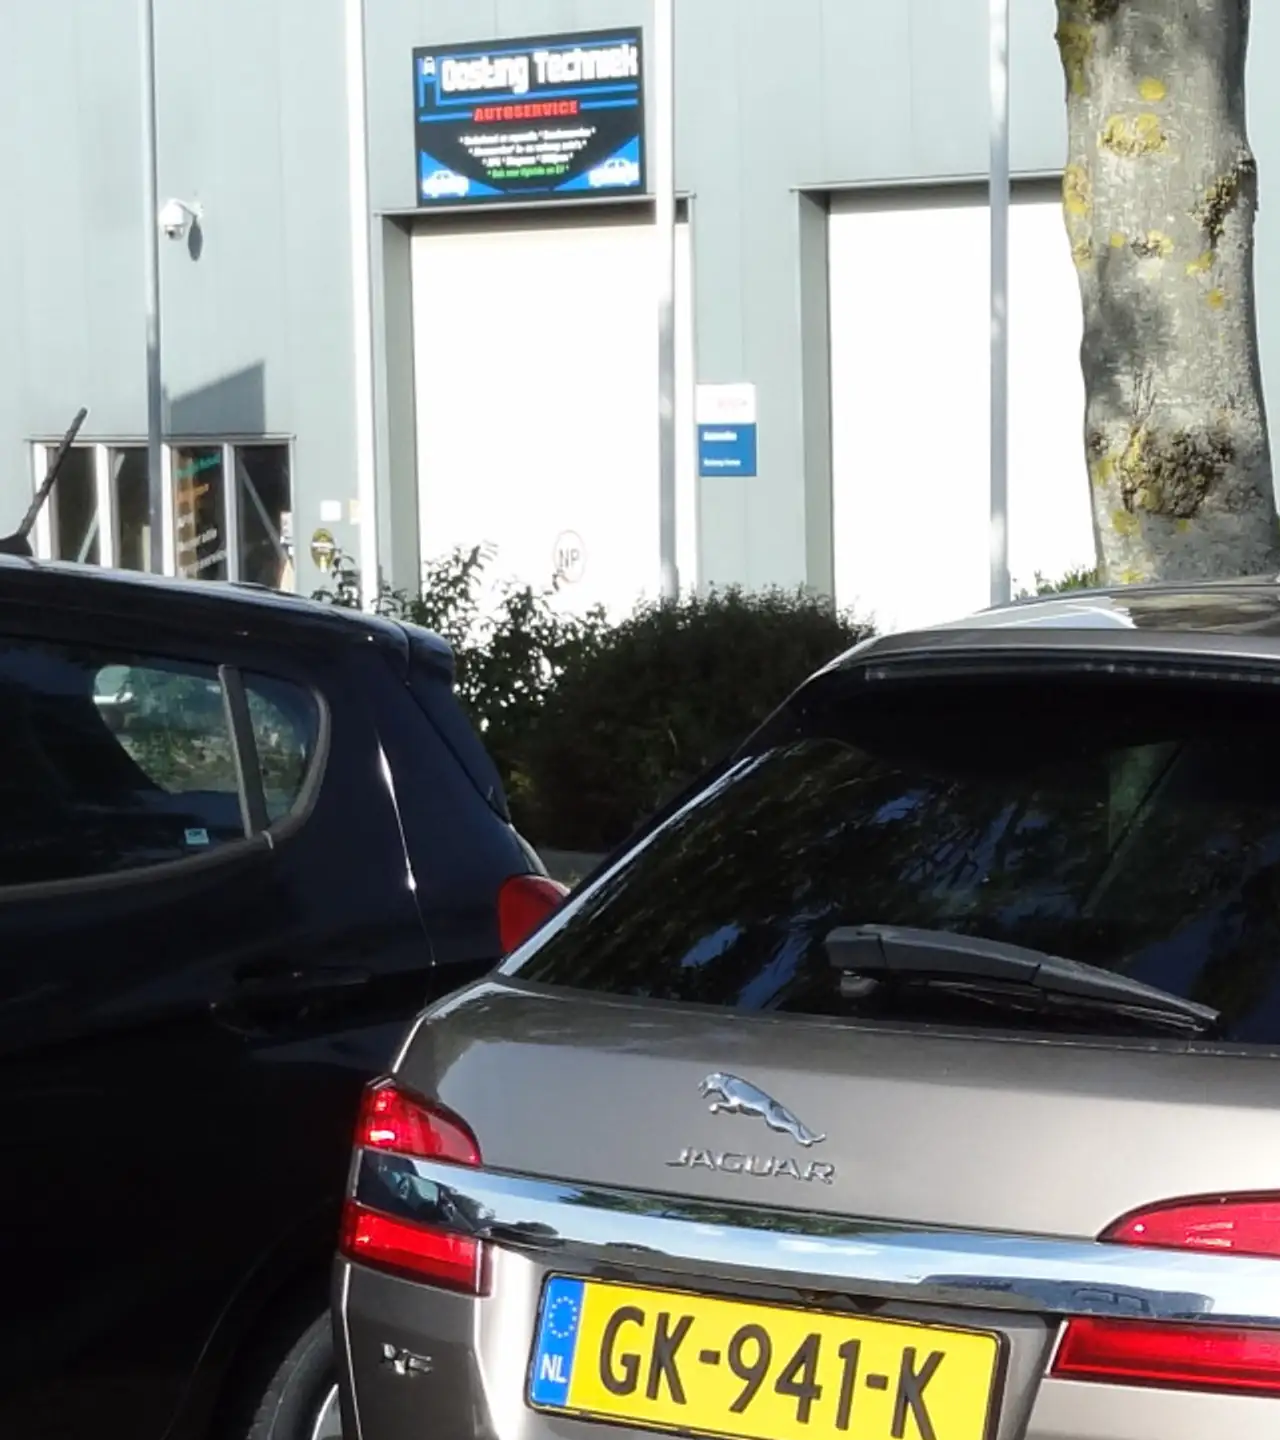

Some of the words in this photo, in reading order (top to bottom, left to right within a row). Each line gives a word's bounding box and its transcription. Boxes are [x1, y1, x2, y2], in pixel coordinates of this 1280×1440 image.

[533, 43, 639, 84] Techniek
[473, 100, 579, 122] AUTOSERVICE
[666, 1147, 836, 1185] JAGUAR
[540, 1352, 568, 1385] NL
